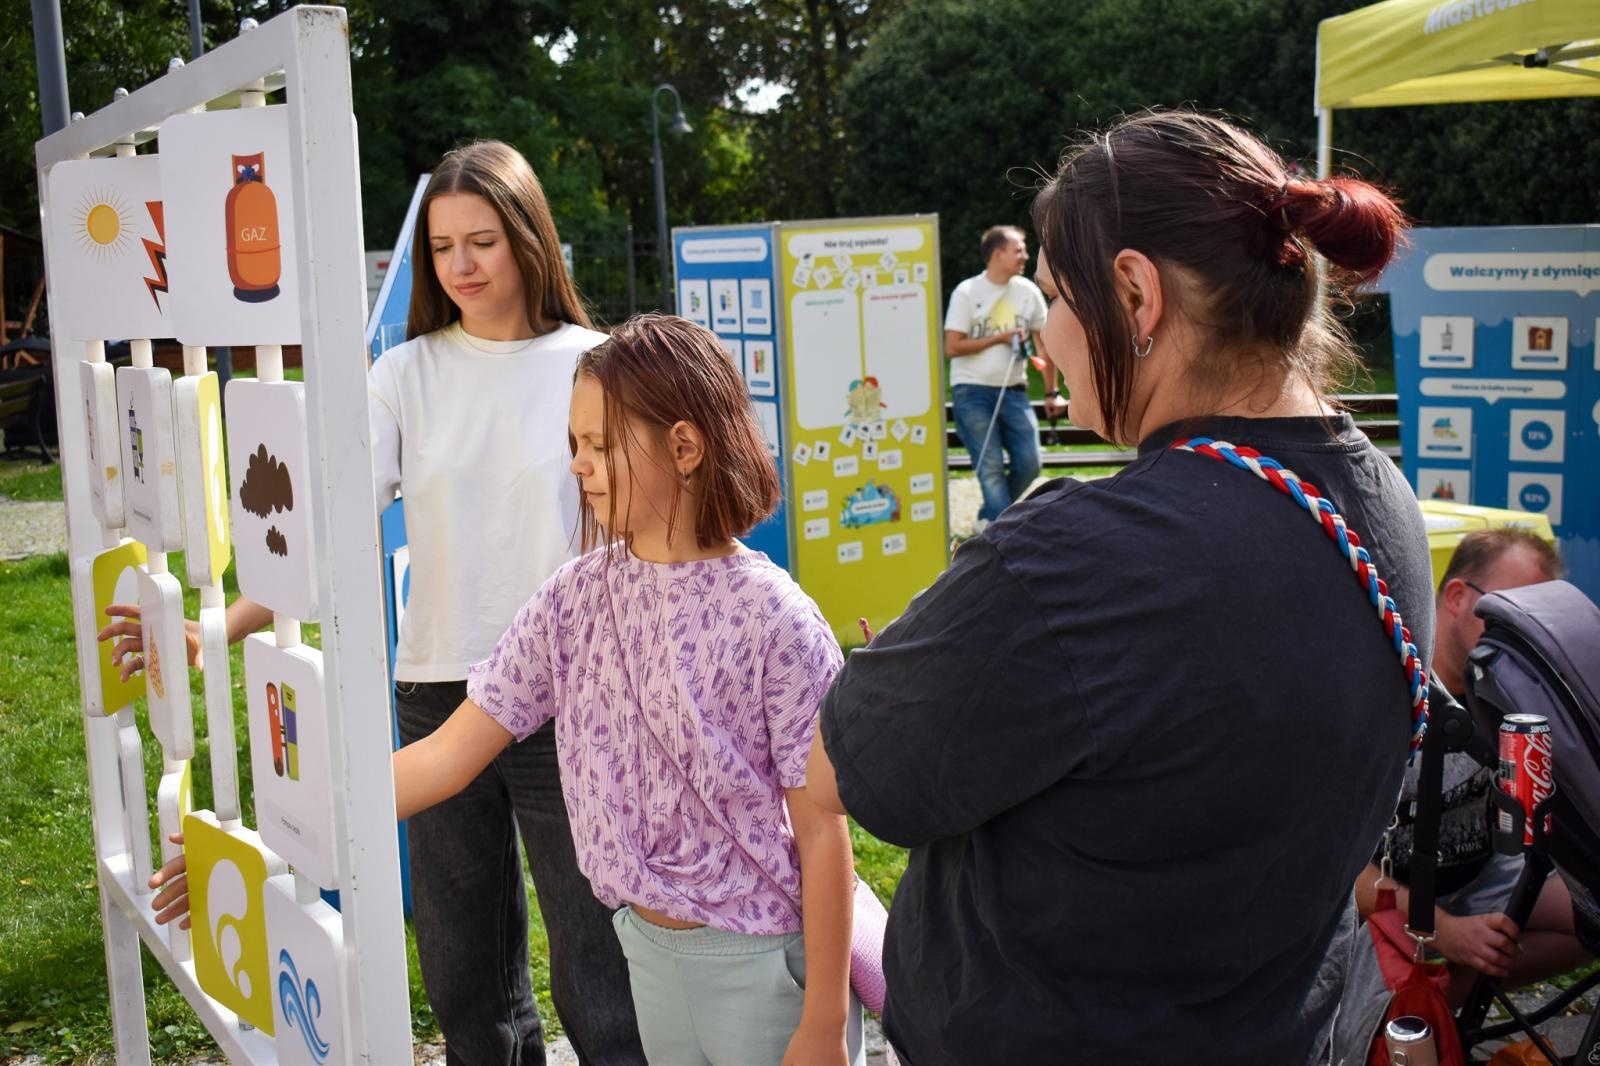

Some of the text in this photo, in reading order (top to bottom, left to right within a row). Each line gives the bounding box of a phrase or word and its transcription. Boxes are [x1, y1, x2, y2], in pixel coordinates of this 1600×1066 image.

[241, 227, 267, 242] GAZ
[824, 240, 837, 249] Nie
[1450, 265, 1529, 280] Walczymy
[1532, 267, 1539, 277] z
